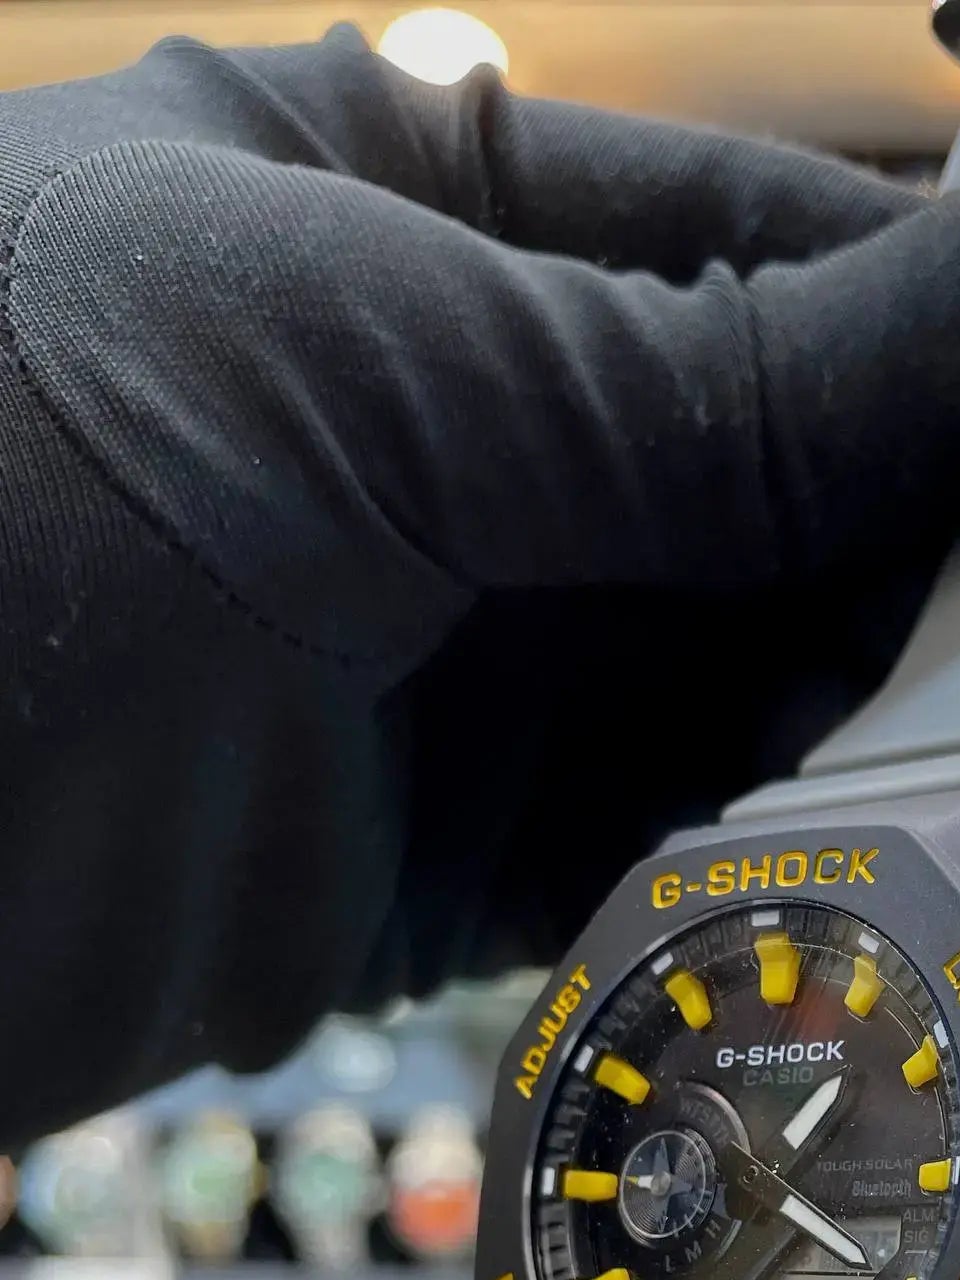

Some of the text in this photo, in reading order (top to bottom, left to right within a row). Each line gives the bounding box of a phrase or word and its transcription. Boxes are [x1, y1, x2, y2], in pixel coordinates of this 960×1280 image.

[651, 847, 881, 910] G-SHOCK
[514, 963, 591, 1100] ADJUST
[715, 1040, 846, 1069] G-SHOCK
[742, 1066, 815, 1087] CASIO
[863, 1158, 914, 1171] SOLAR
[903, 1207, 936, 1222] ALM
[903, 1230, 929, 1244] SIG
